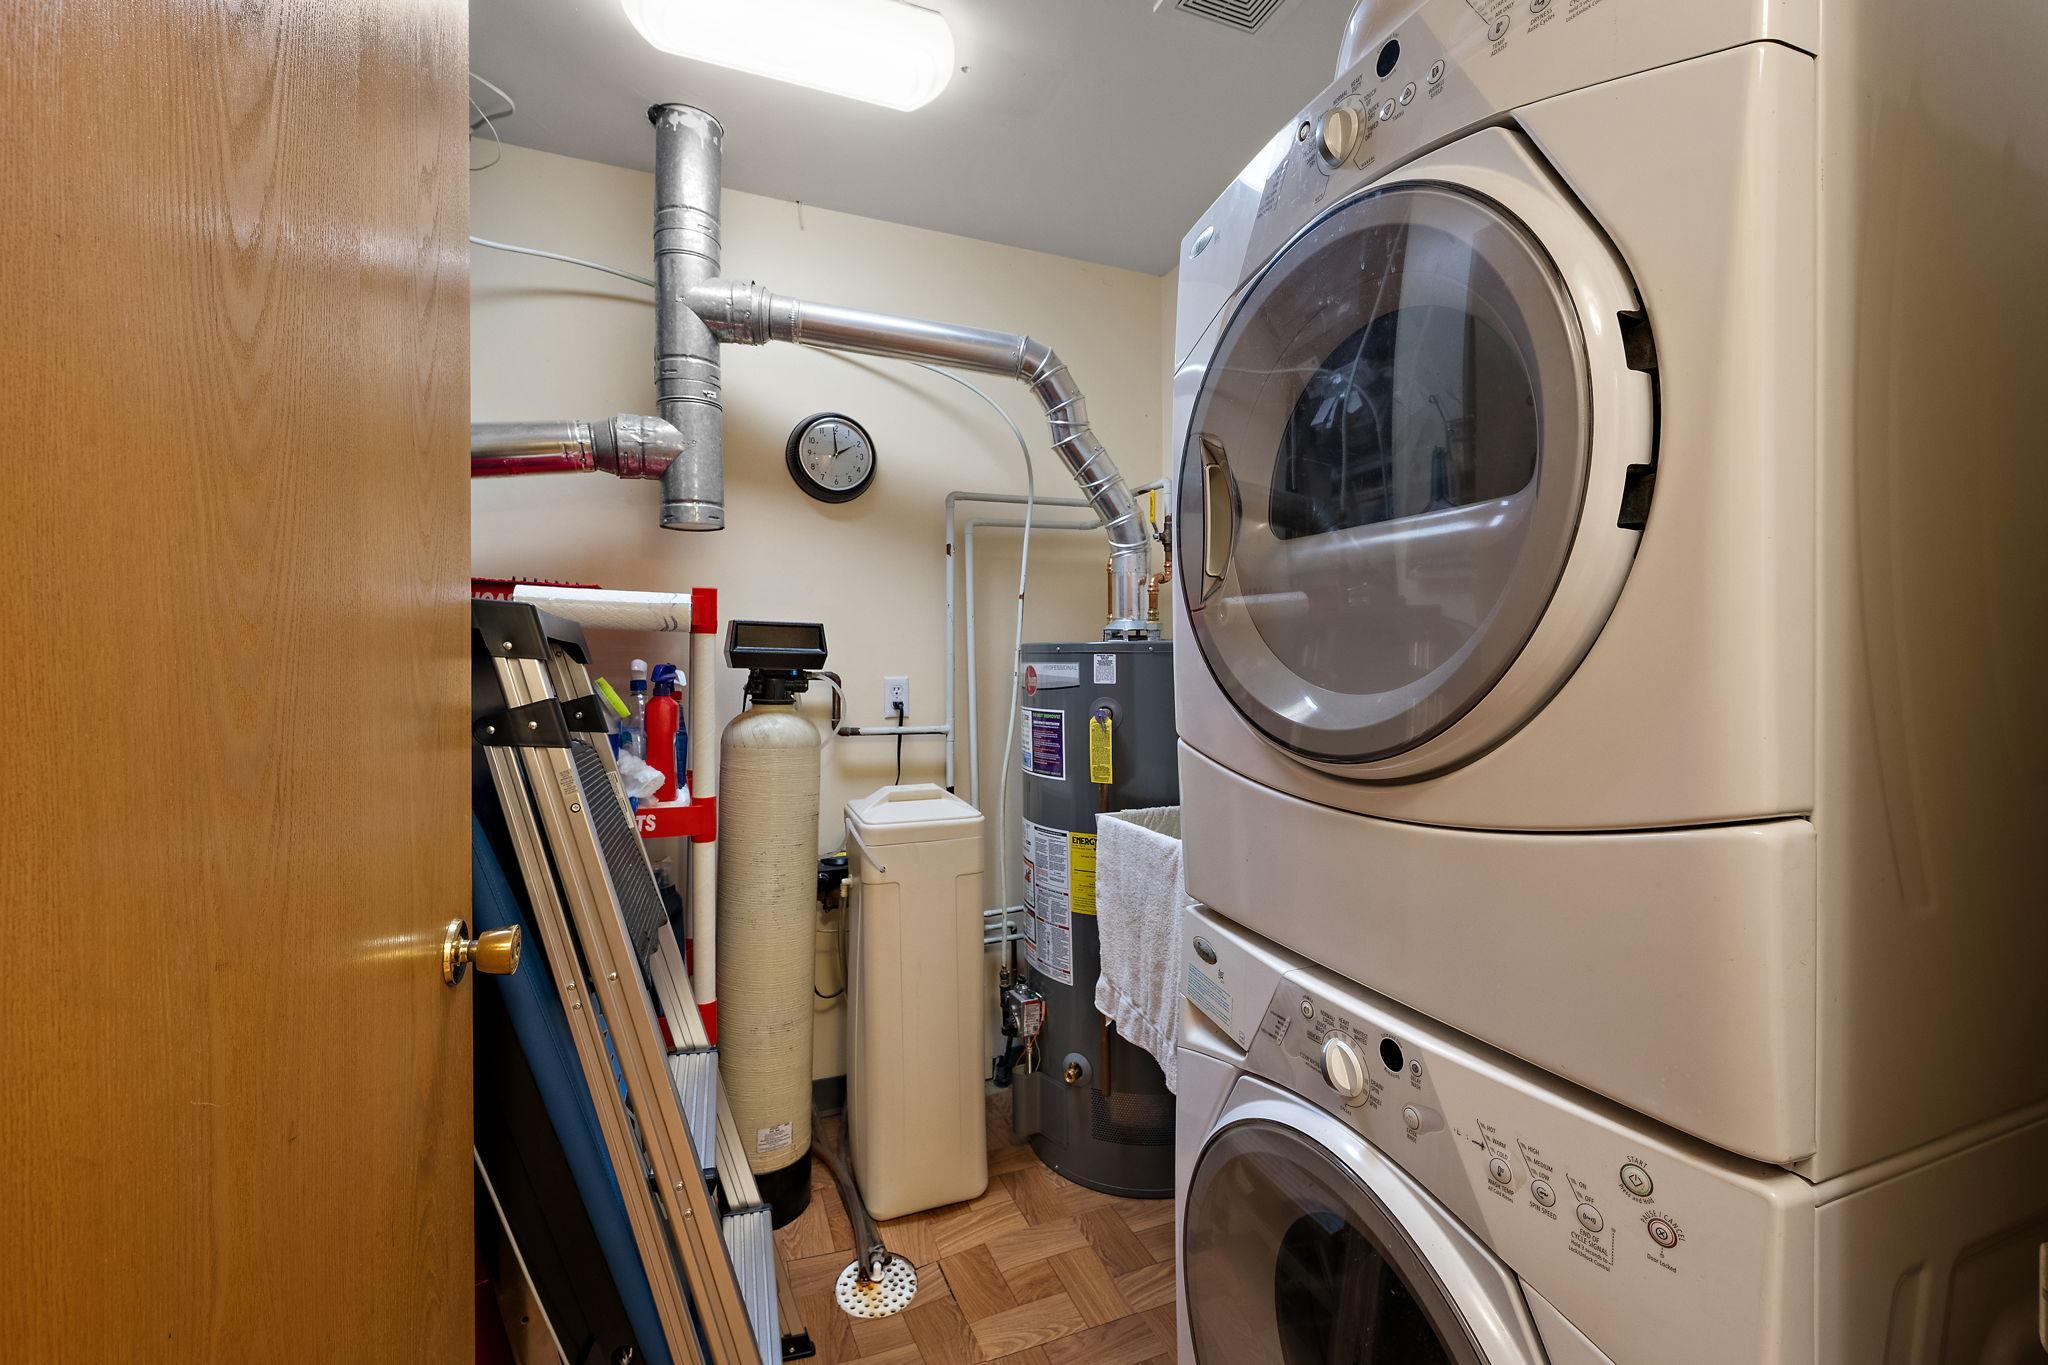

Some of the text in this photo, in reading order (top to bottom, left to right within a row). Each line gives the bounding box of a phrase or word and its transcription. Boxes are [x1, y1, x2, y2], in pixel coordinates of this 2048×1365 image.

[1530, 8, 1552, 25] DRYNESS
[1527, 14, 1555, 34] Auto Cycles
[1490, 42, 1508, 56] ADJUST
[1487, 1125, 1496, 1134] HOT
[1492, 1138, 1507, 1149] WARM
[1527, 1145, 1540, 1156] HIGH
[1496, 1150, 1509, 1160] COLD
[1626, 1155, 1648, 1169] START
[1533, 1158, 1553, 1173] MEDIUM
[1538, 1171, 1550, 1181] LOW
[1501, 1184, 1515, 1196] TEMP
[1578, 1181, 1587, 1190] ON
[1584, 1195, 1595, 1204] OFF
[1618, 1183, 1655, 1205] Press and Hold
[1529, 1201, 1557, 1220] SPIN SPEED
[1640, 1209, 1657, 1224] PAUSE
[1663, 1214, 1686, 1242] CANCEL
[1579, 1228, 1600, 1243] END OF
[1570, 1239, 1581, 1248] Hold
[1585, 1246, 1602, 1261] seconds
[1571, 1231, 1609, 1257] CYCLE SIGNAL
[1593, 1259, 1611, 1272] Control
[1646, 1253, 1677, 1274] Door Locked
